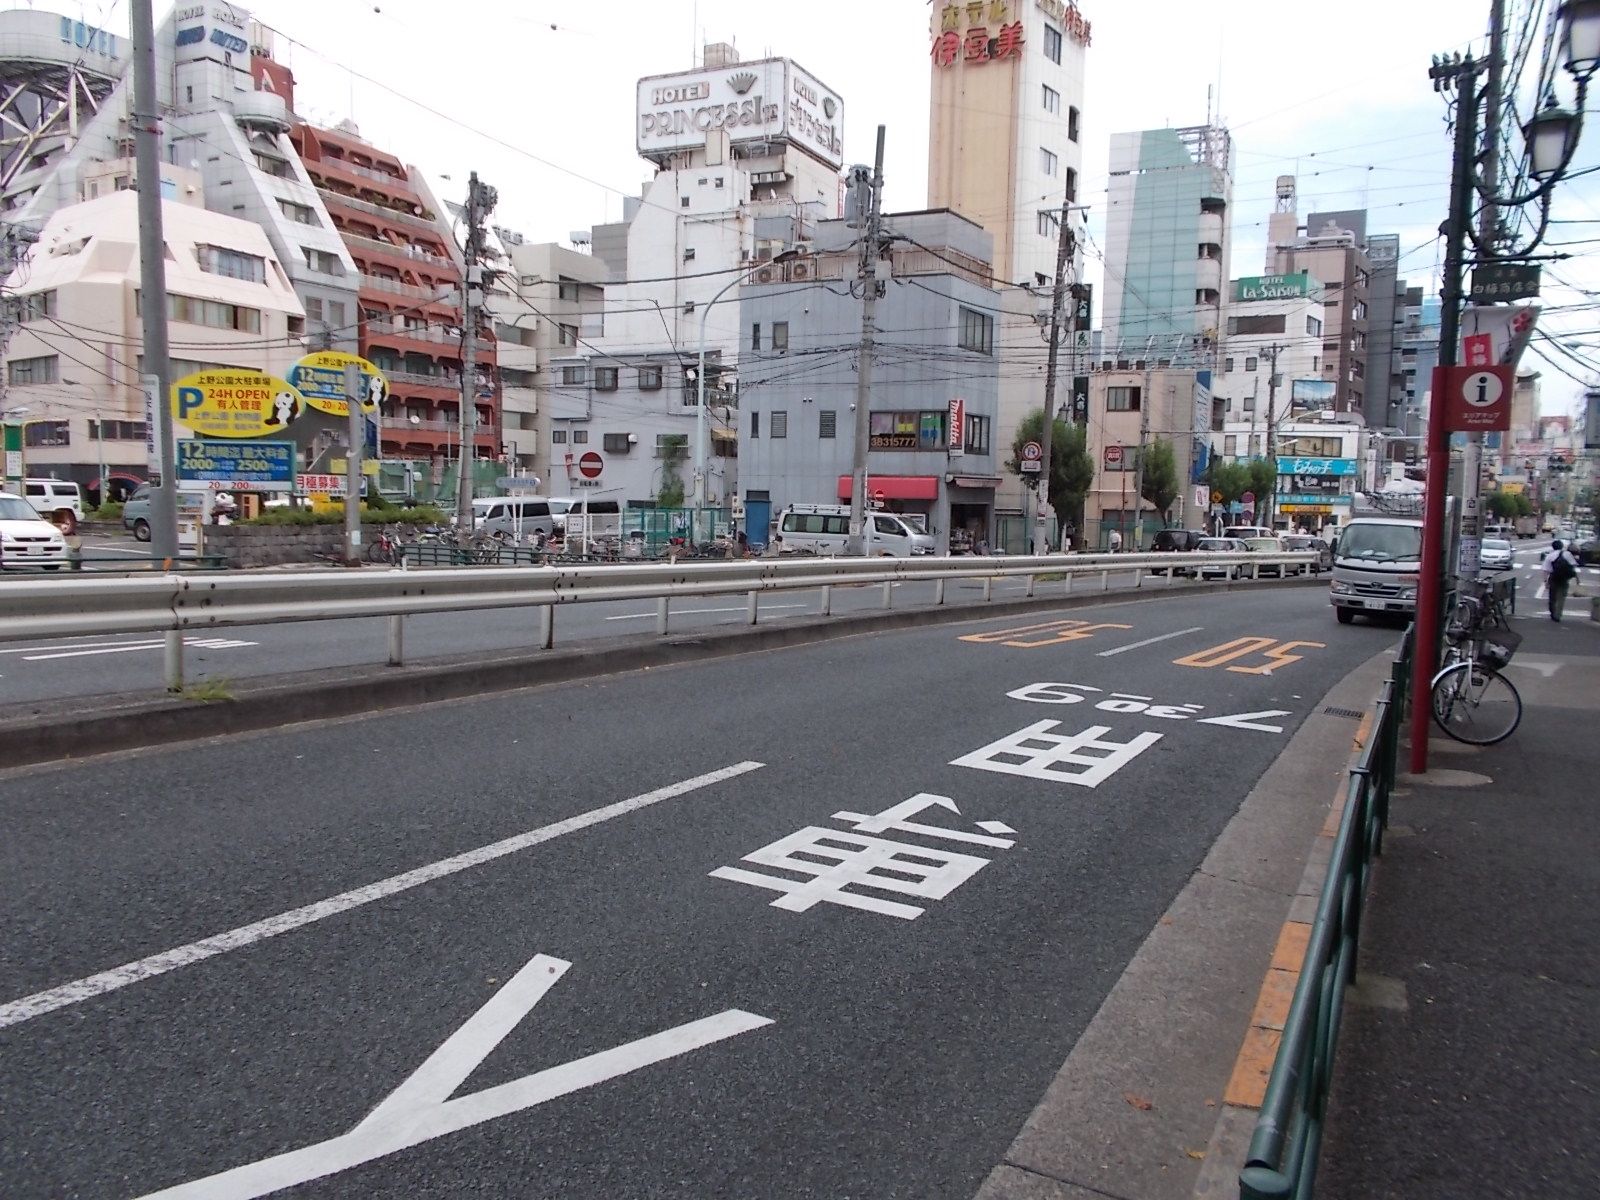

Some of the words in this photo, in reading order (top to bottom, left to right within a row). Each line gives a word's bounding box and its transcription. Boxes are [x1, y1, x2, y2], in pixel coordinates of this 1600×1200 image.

[930, 21, 1025, 66] 伊豆美
[653, 82, 710, 105] HOTEL
[178, 387, 204, 419] P
[208, 389, 233, 399] 24H
[235, 389, 270, 400] OPEN
[218, 400, 261, 410] 有人管理
[949, 400, 960, 446] makita
